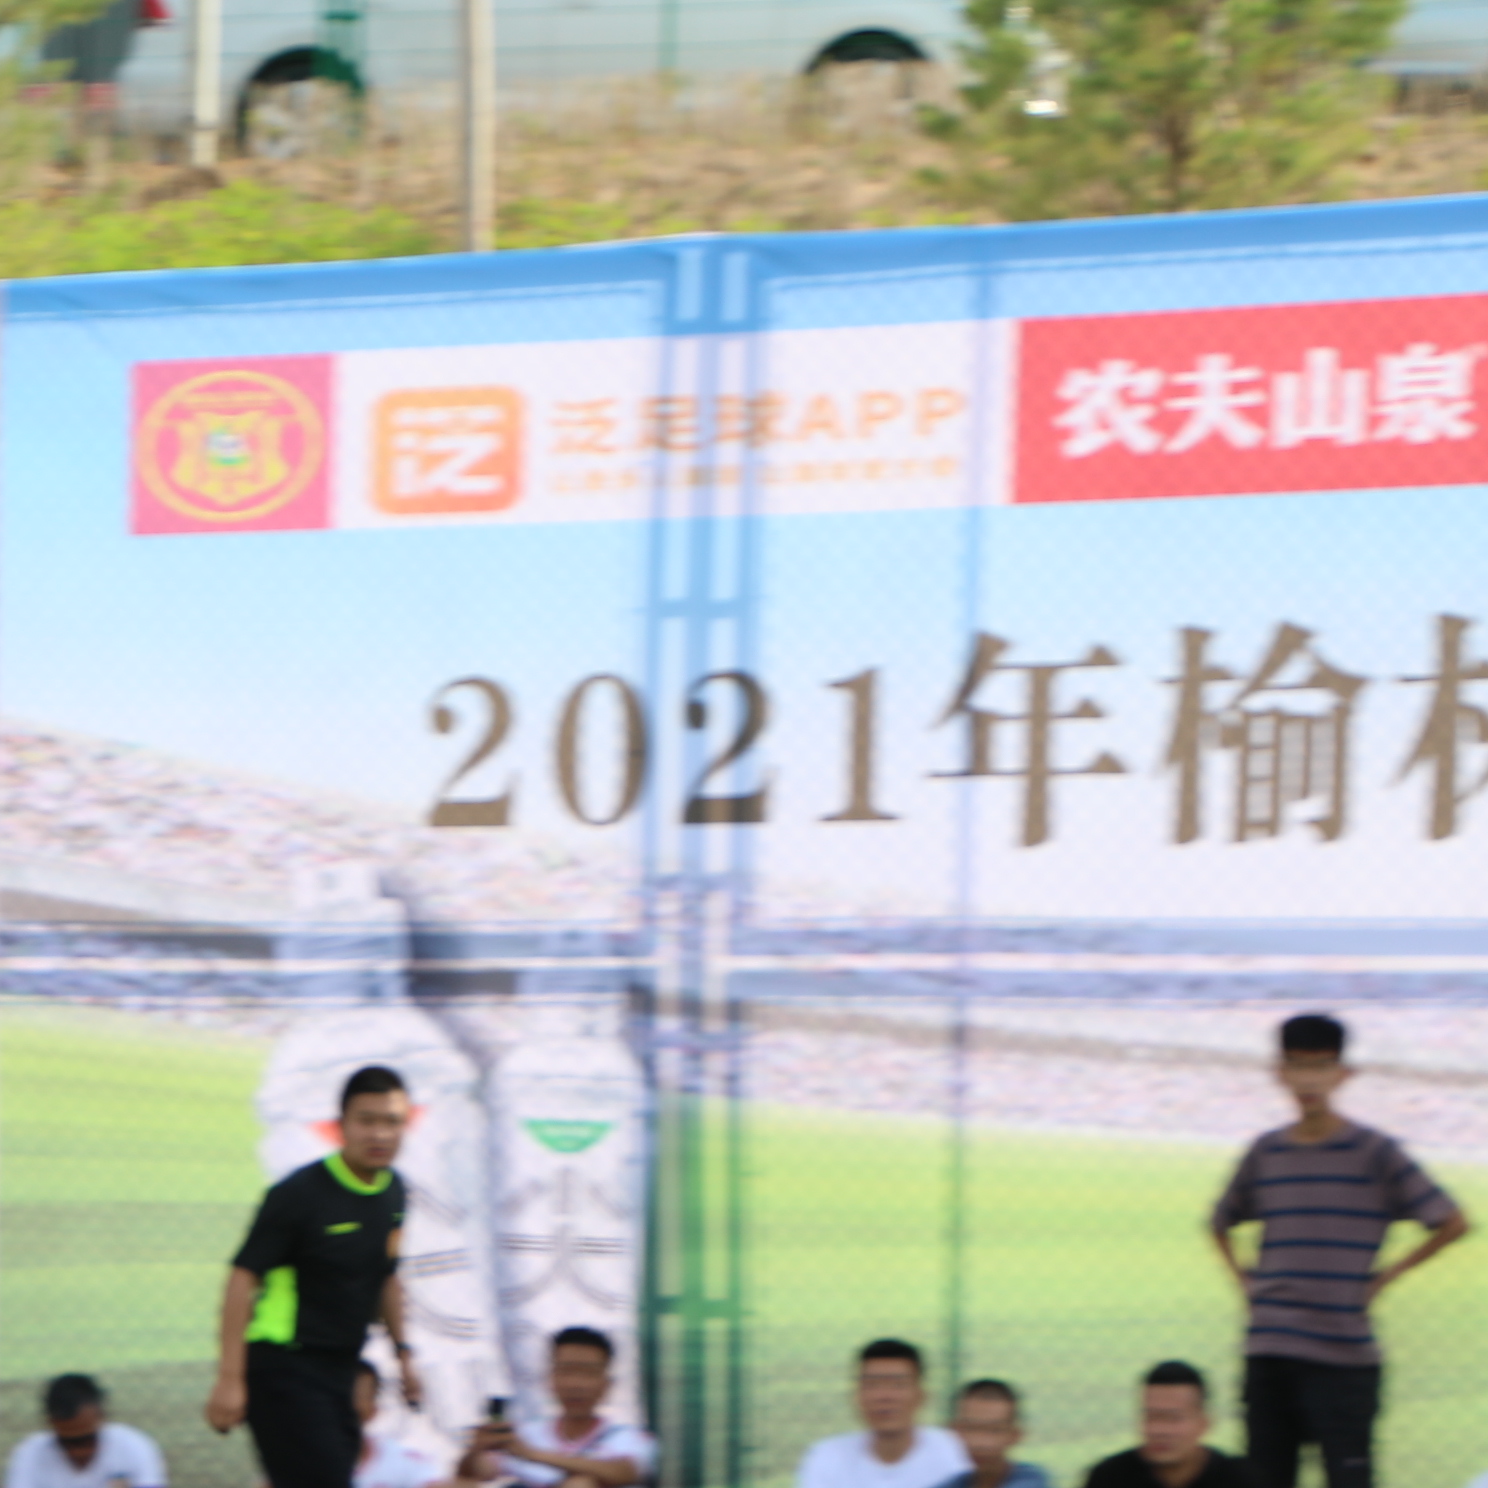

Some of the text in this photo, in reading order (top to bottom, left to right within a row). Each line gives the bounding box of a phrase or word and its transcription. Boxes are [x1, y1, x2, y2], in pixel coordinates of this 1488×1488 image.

[388, 403, 502, 498] 泛
[1052, 341, 1479, 457] 农夫山泉
